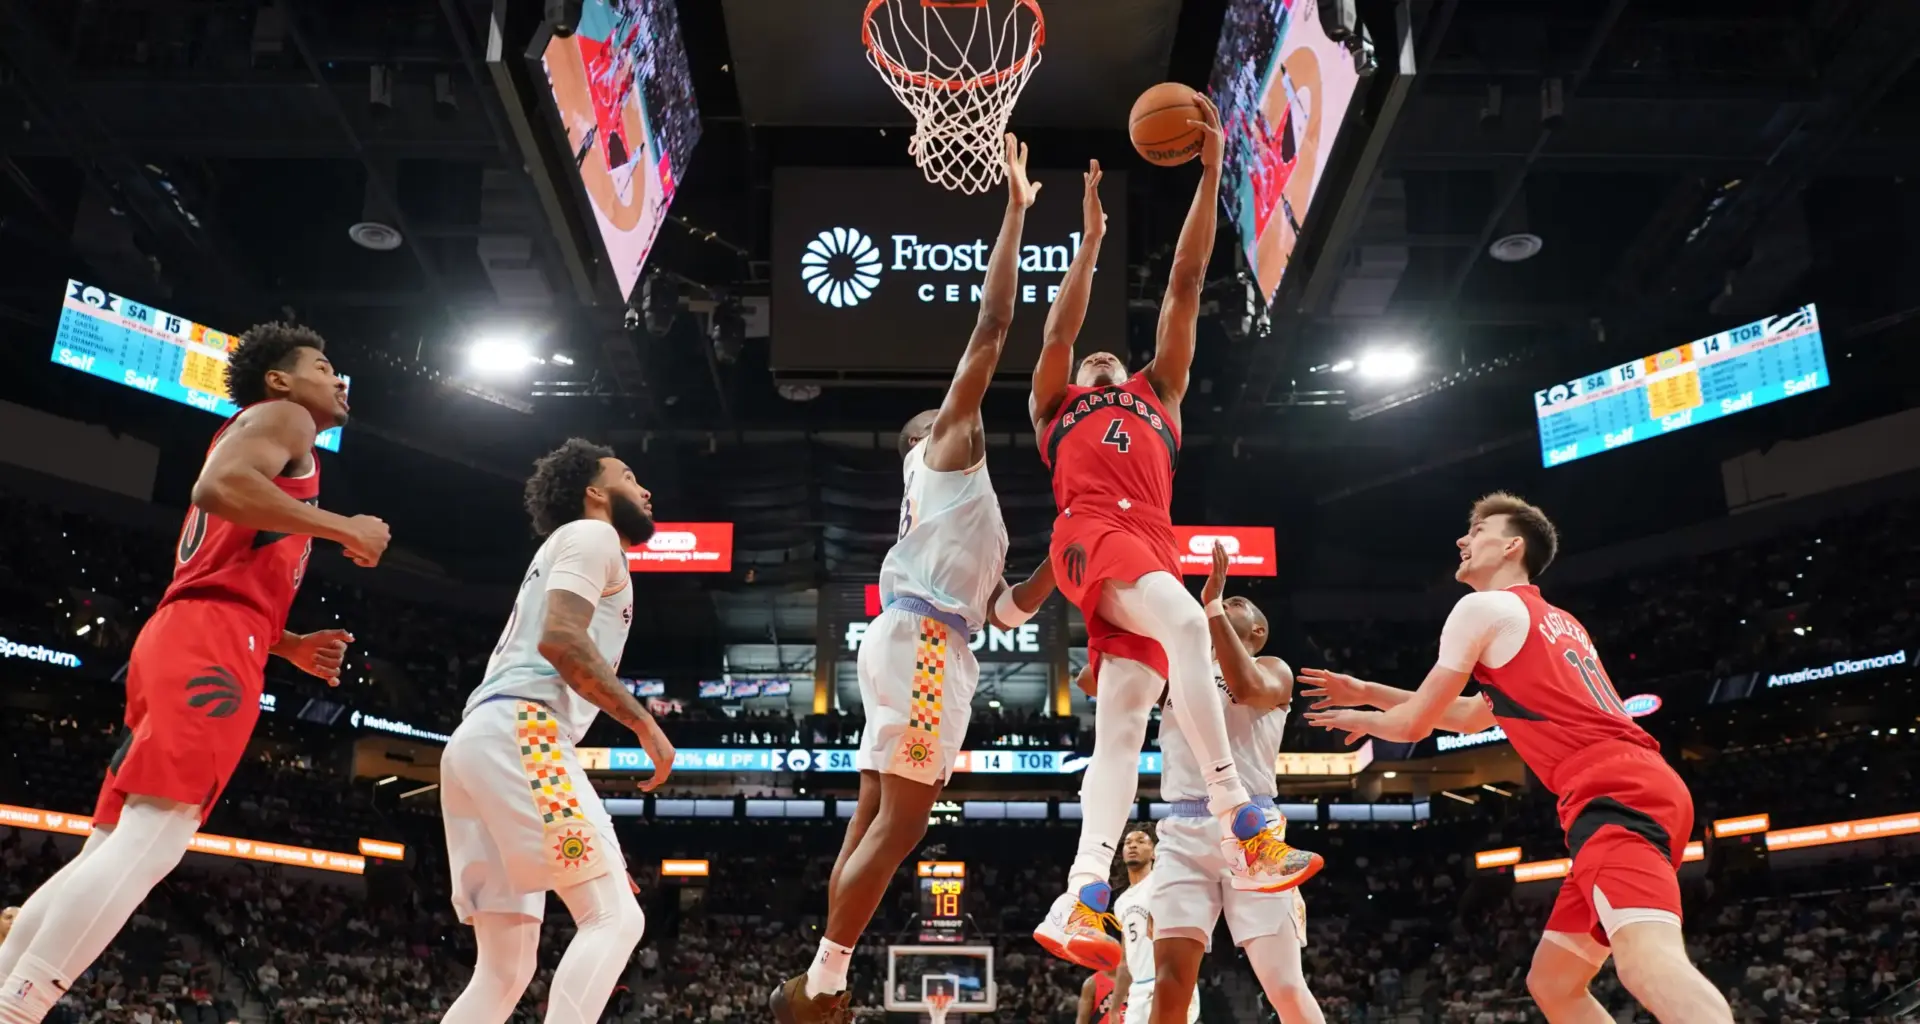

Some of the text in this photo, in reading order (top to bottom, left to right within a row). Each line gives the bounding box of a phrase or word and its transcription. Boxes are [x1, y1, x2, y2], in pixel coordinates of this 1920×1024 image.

[890, 234, 988, 272] Frost
[918, 284, 1062, 302] CENER
[128, 304, 181, 334] SA 15
[1703, 324, 1762, 354] 14 TOR
[59, 348, 95, 371] Self
[124, 369, 159, 392] Self
[186, 390, 220, 412] Self
[1587, 376, 1605, 391] SA
[1620, 364, 1635, 381] 15
[1063, 392, 1162, 430] RAPTORS
[1549, 443, 1578, 465] Self
[1603, 426, 1634, 449] Self
[1661, 408, 1692, 432] Self
[1720, 391, 1753, 414] Self
[1784, 372, 1818, 396] Self
[1101, 418, 1131, 453] 4
[1538, 611, 1598, 661] CASTLETON
[0, 636, 77, 668] Spectrum
[1767, 649, 1906, 688] Americus Diamond
[1563, 647, 1633, 721] 11
[363, 714, 412, 736] Methodist
[1436, 725, 1508, 752] Bitdefende
[615, 751, 638, 766] TO
[830, 752, 852, 768] SA
[984, 755, 1001, 769] 14
[1018, 754, 1053, 769] TOR
[931, 880, 961, 895] 6:43
[936, 893, 957, 916] 18
[1128, 922, 1138, 943] 5
